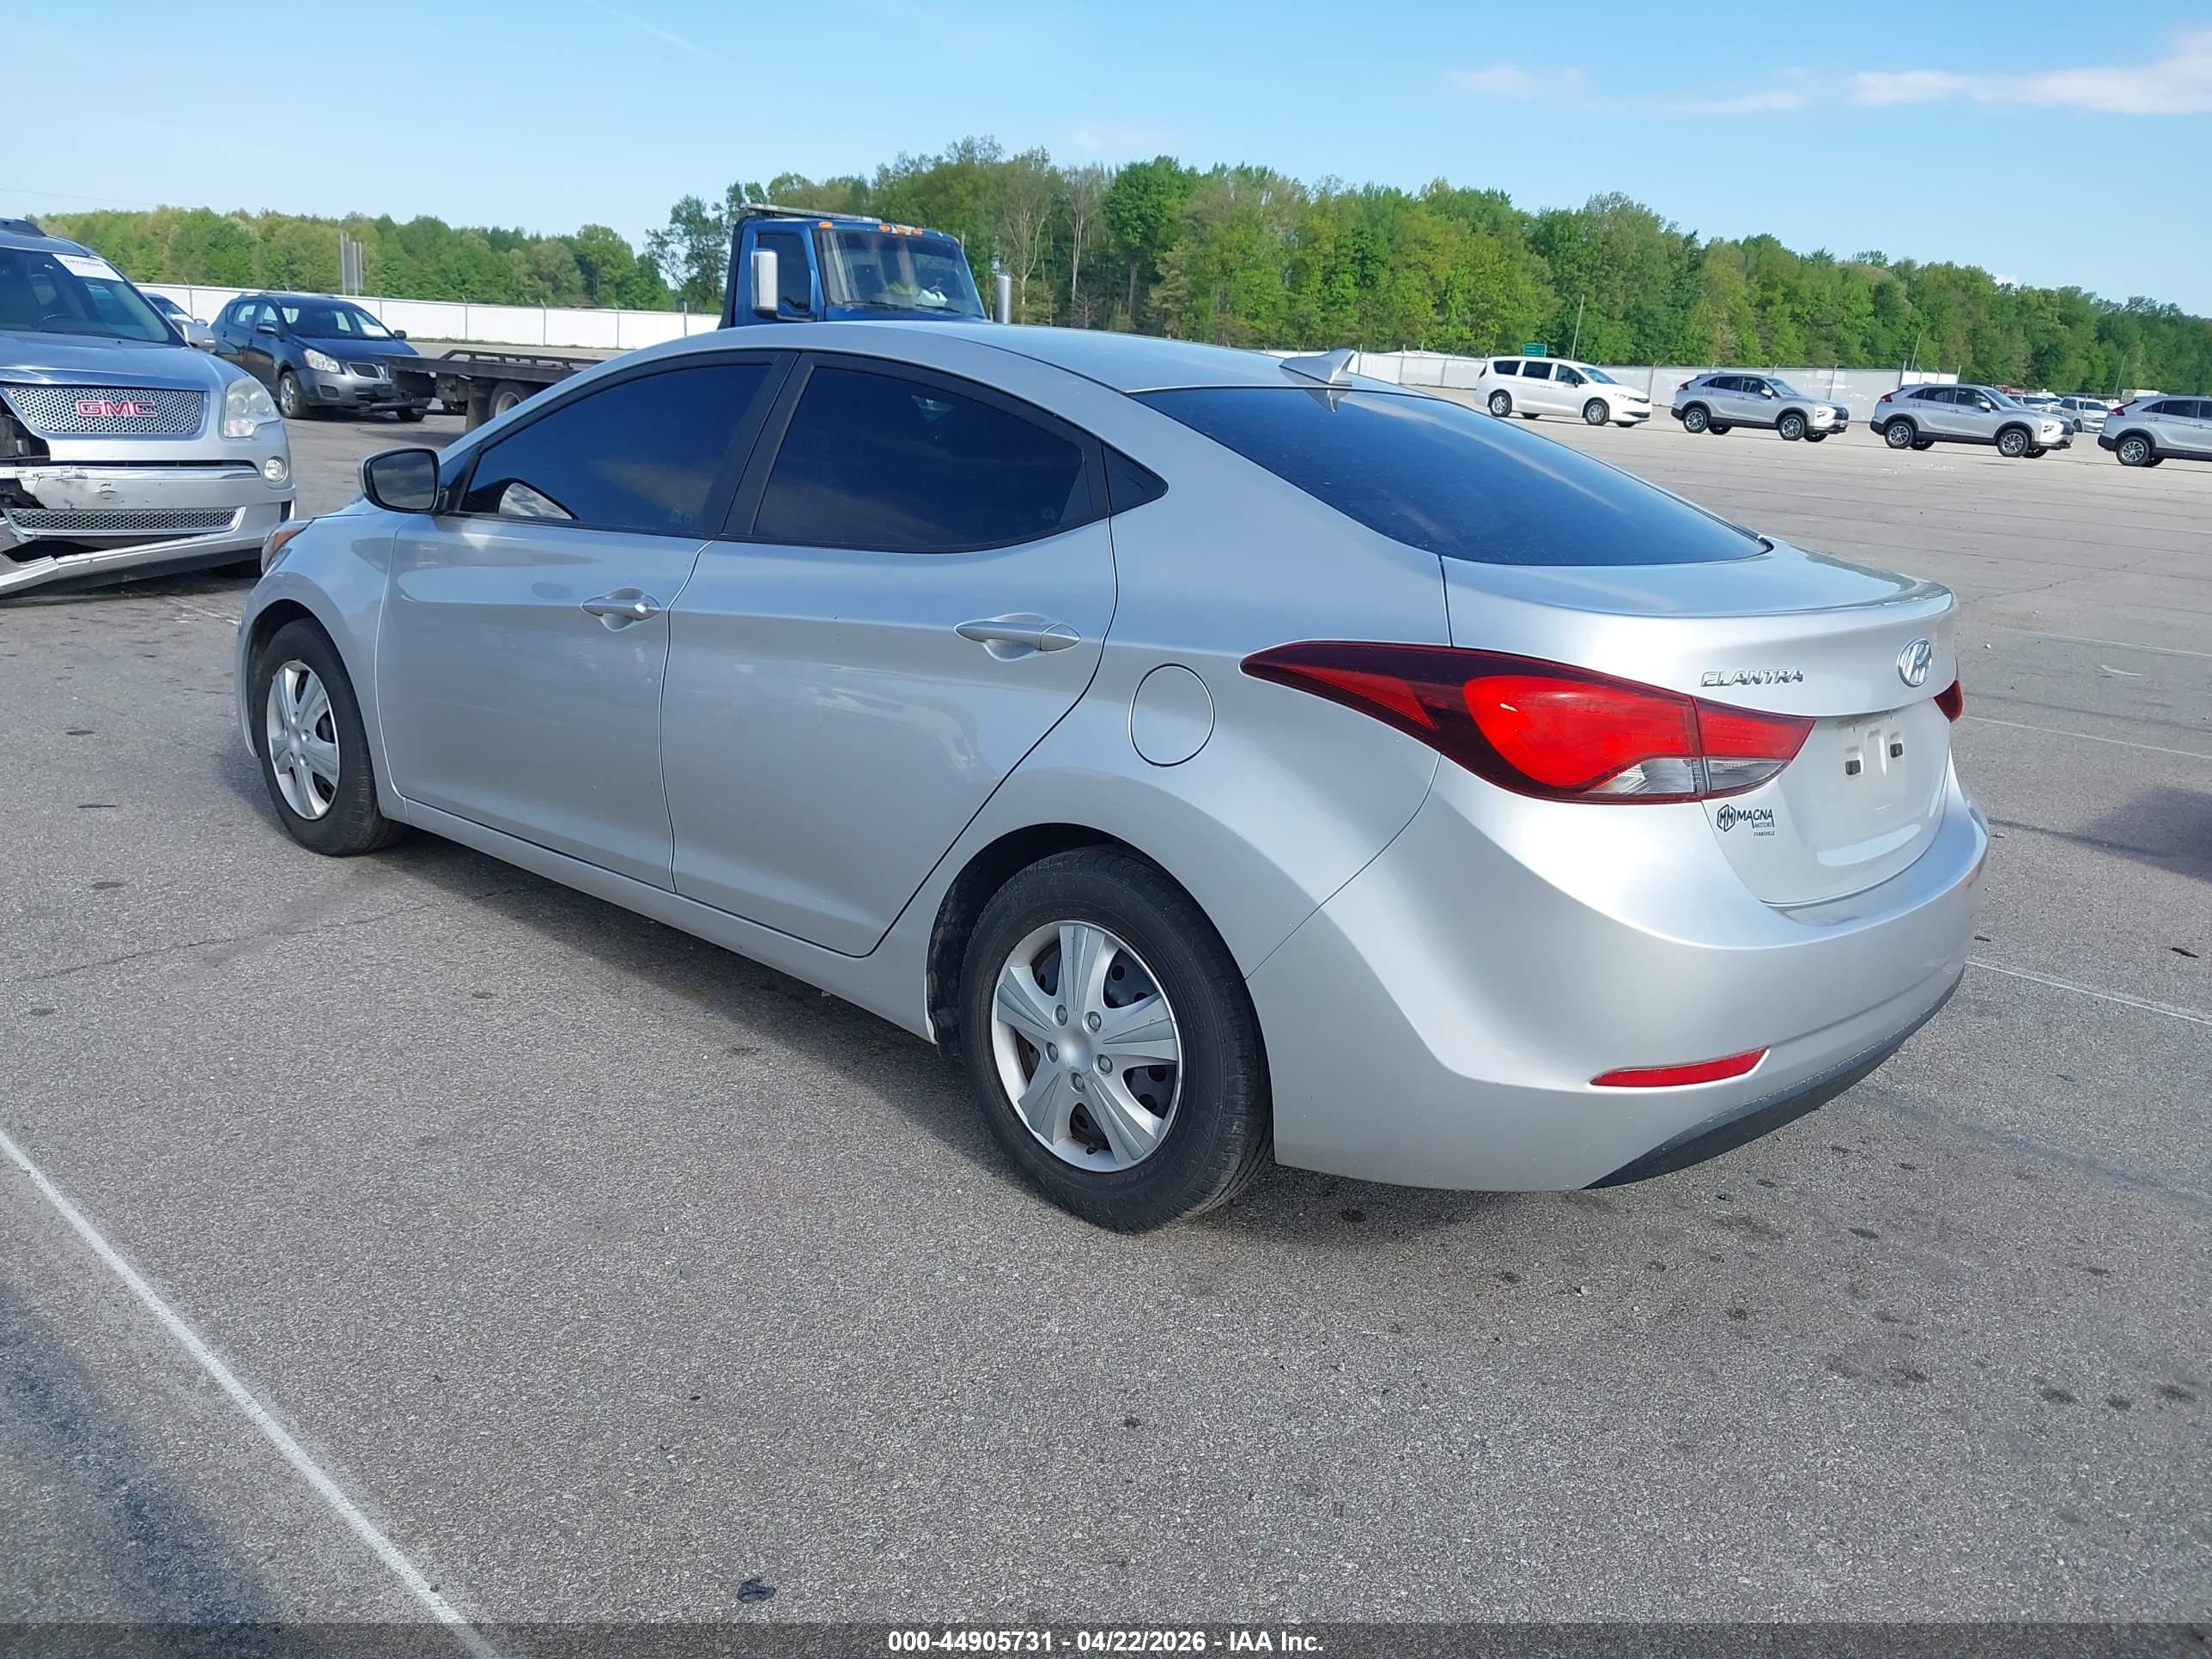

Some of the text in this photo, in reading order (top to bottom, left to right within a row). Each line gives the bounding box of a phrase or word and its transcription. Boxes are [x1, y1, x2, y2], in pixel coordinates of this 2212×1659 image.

[76, 400, 157, 417] GMC
[1700, 669, 1803, 688] ELANTRA
[1736, 809, 1775, 829] MAGNA
